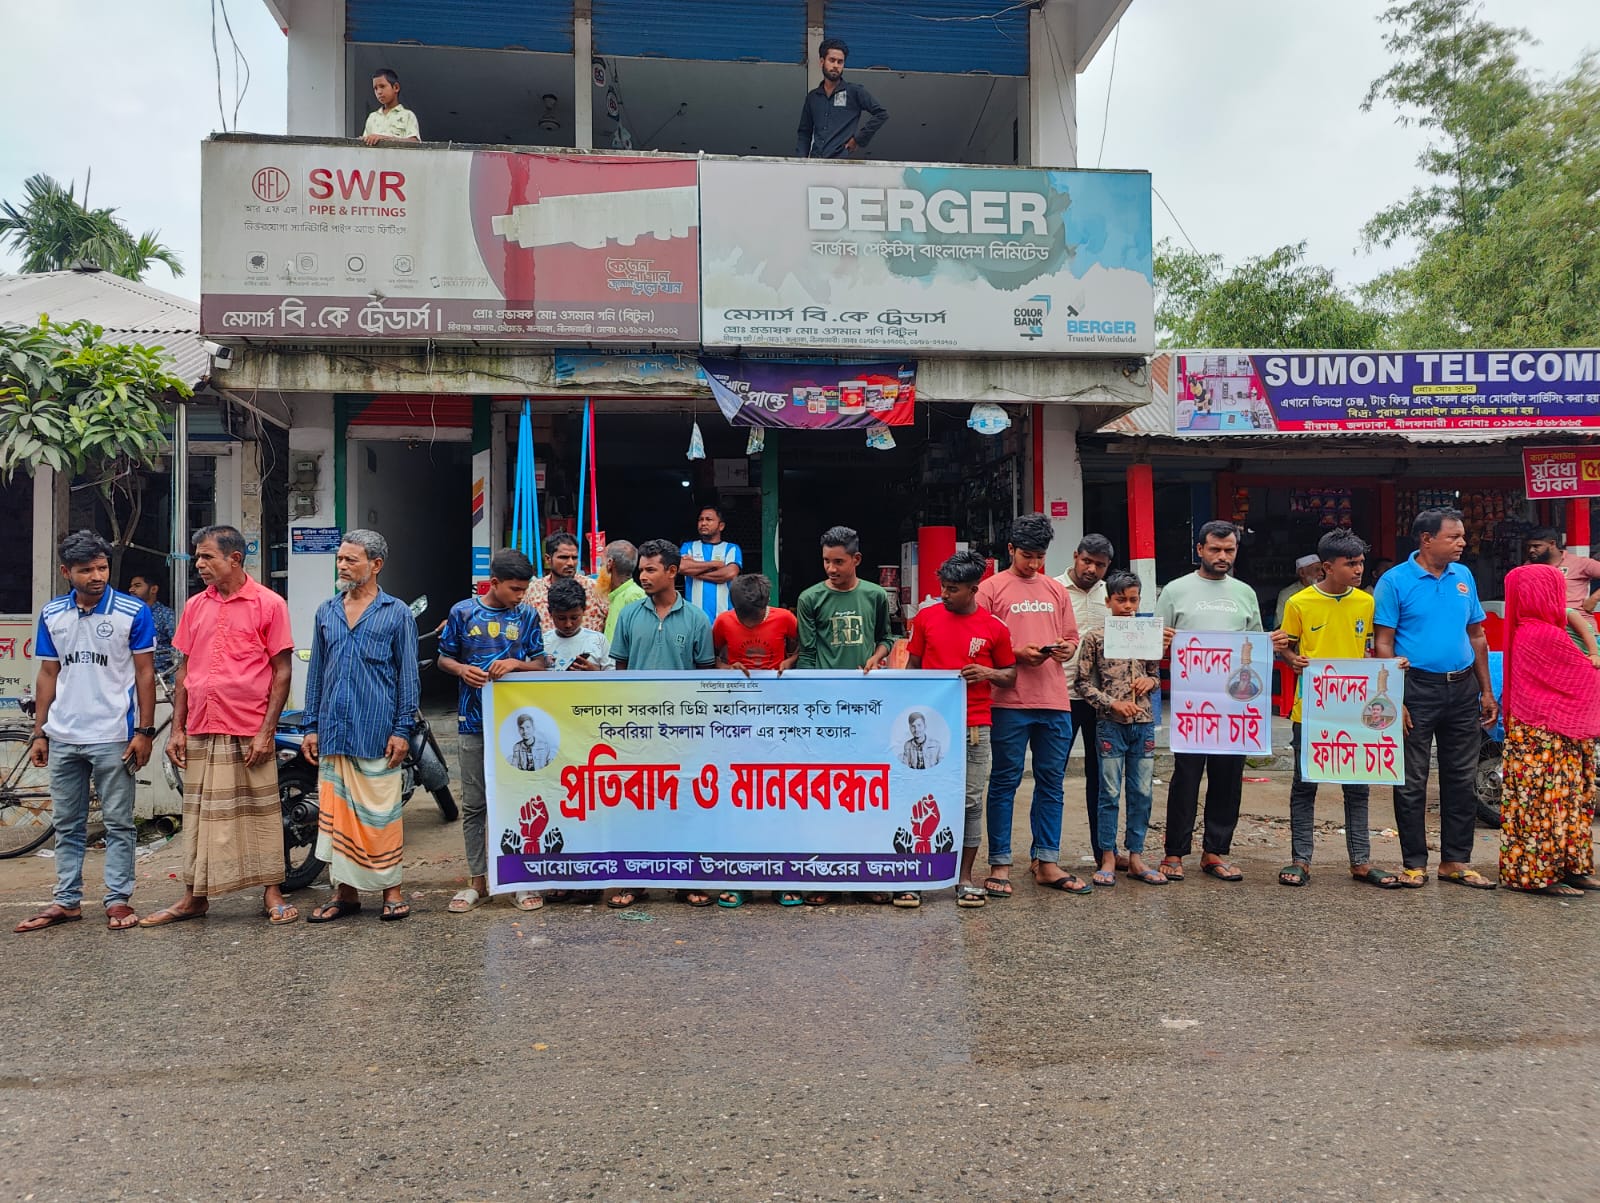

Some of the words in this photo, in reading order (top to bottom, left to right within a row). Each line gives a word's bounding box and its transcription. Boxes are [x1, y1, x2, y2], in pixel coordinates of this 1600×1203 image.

[257, 170, 285, 199] RFL
[309, 168, 407, 202] SWR
[309, 205, 336, 216] PIPE
[339, 206, 347, 216] &
[351, 206, 407, 218] FITTINGS
[808, 187, 1048, 235] BERGER
[812, 239, 857, 256] বার্জার
[920, 244, 985, 260] বাংলাদেশ
[989, 241, 1049, 260] লিমিটেড
[222, 308, 275, 327] মেসার্স
[559, 311, 594, 321] ওসমান
[723, 307, 794, 321] মেসার্স
[877, 309, 948, 325] ট্রেডার্স
[1014, 308, 1043, 317] COLOR
[1014, 317, 1043, 326] BANK
[822, 328, 861, 336] ওসমান
[1067, 320, 1136, 334] BERGER
[1098, 335, 1137, 343] Worldwide
[1265, 355, 1404, 387] SUMON
[1416, 352, 1600, 383] TELECOM
[1281, 398, 1310, 408] এখানে
[1413, 395, 1432, 405] এবং
[1435, 395, 1458, 404] সকল
[1461, 394, 1486, 404] প্রকার
[1489, 392, 1525, 404] মোবাইল
[1566, 394, 1584, 403] করা
[1376, 408, 1407, 419] পুরাতন
[1411, 406, 1447, 416] মোবাইল
[1501, 407, 1517, 415] করা
[1530, 459, 1577, 480] সুবিধা
[1584, 461, 1600, 479] ৫
[1530, 477, 1578, 492] ডাবল
[1011, 600, 1054, 614] adidas
[971, 637, 986, 647] JUST
[1177, 637, 1233, 679] খুনিদের
[1313, 663, 1369, 709] খুনিদের
[571, 704, 623, 717] জলঢাকা
[628, 701, 675, 716] সরকারি
[680, 701, 708, 716] ডিগ্রি
[714, 701, 799, 716] মহাবিদ্যালয়ের
[804, 700, 832, 720] কৃতি
[835, 699, 883, 716] শিক্ষার্থী
[599, 722, 653, 740] কিবরিয়া
[658, 722, 704, 739] ইসলাম
[709, 721, 752, 739] পিয়েল
[756, 726, 774, 738] এর
[779, 726, 811, 741] নৃশংস
[1175, 701, 1220, 745] ফাঁসি
[1228, 704, 1263, 750] চাই
[1311, 730, 1357, 775] ফাঁসি
[1363, 733, 1399, 778] চাই
[561, 743, 680, 821] প্রতিবাদ
[692, 765, 720, 810] ও
[731, 763, 890, 813] মানববন্ধন
[524, 857, 618, 876] আয়োজনেঃ
[624, 857, 692, 876] জলঢাকা
[700, 854, 784, 876] উপজেলার
[790, 854, 860, 877] সর্বস্তরের
